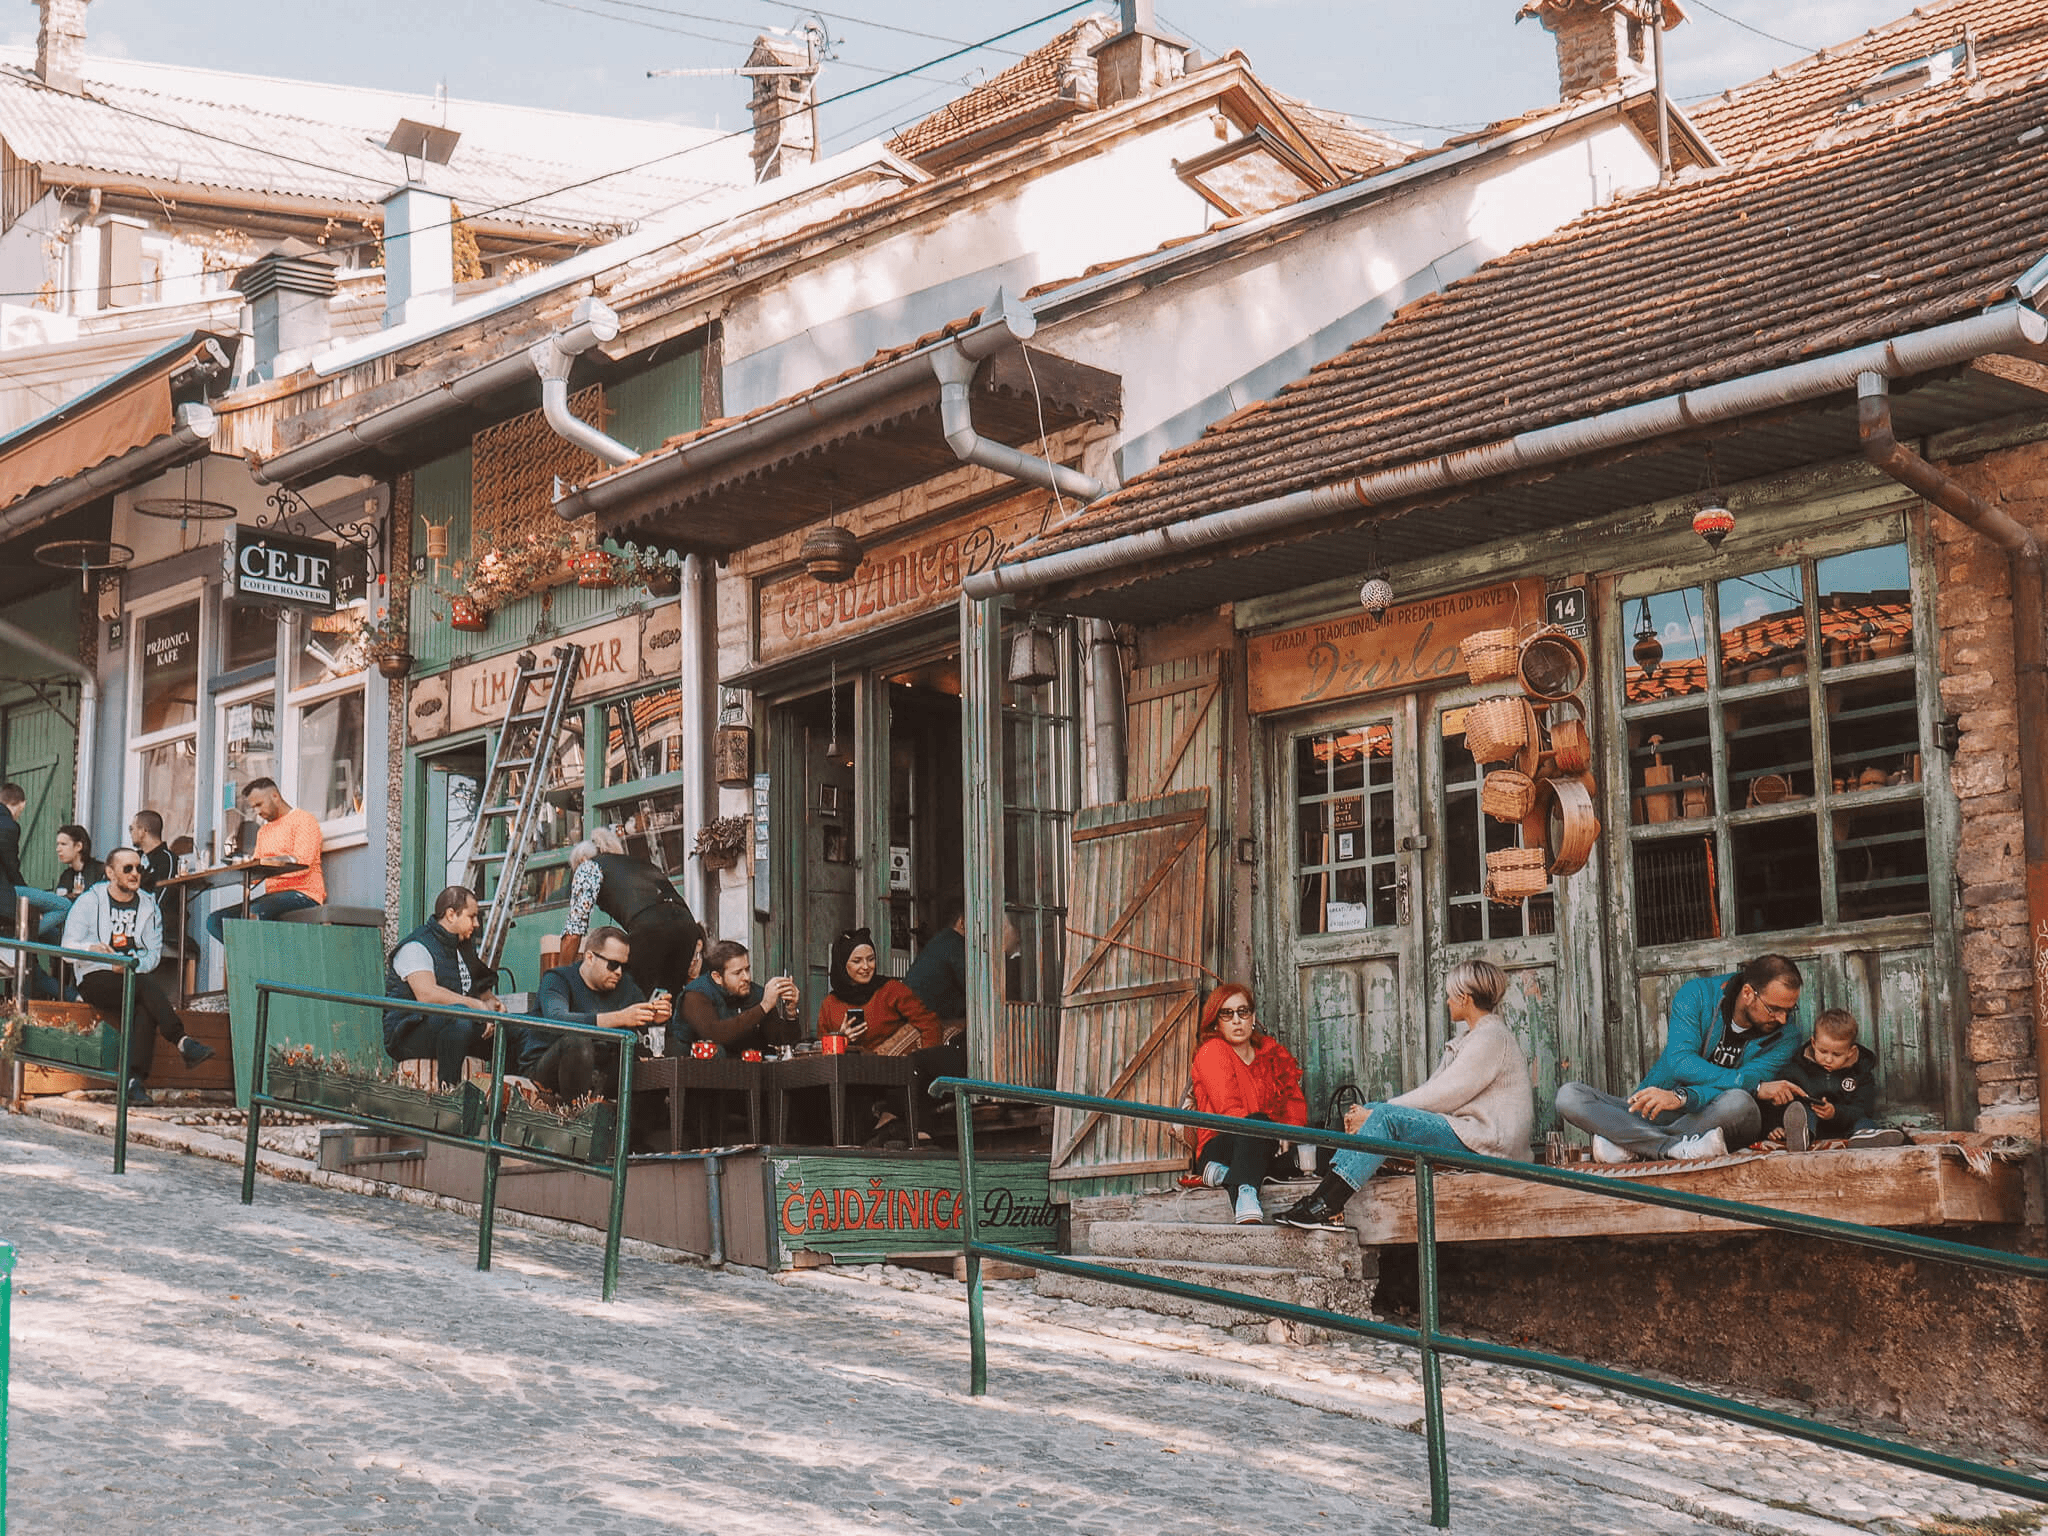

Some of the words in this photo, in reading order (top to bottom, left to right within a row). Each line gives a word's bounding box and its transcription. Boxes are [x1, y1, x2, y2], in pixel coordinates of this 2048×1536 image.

[243, 579, 280, 593] COFFEE
[280, 584, 328, 601] ROASTERS
[1554, 596, 1577, 620] 14
[1271, 631, 1308, 653] IZRADA
[1398, 599, 1456, 626] PREDMETA
[1458, 595, 1475, 614] OD
[146, 631, 191, 657] PRŽIONICA
[978, 1187, 1056, 1228] Džirlo
